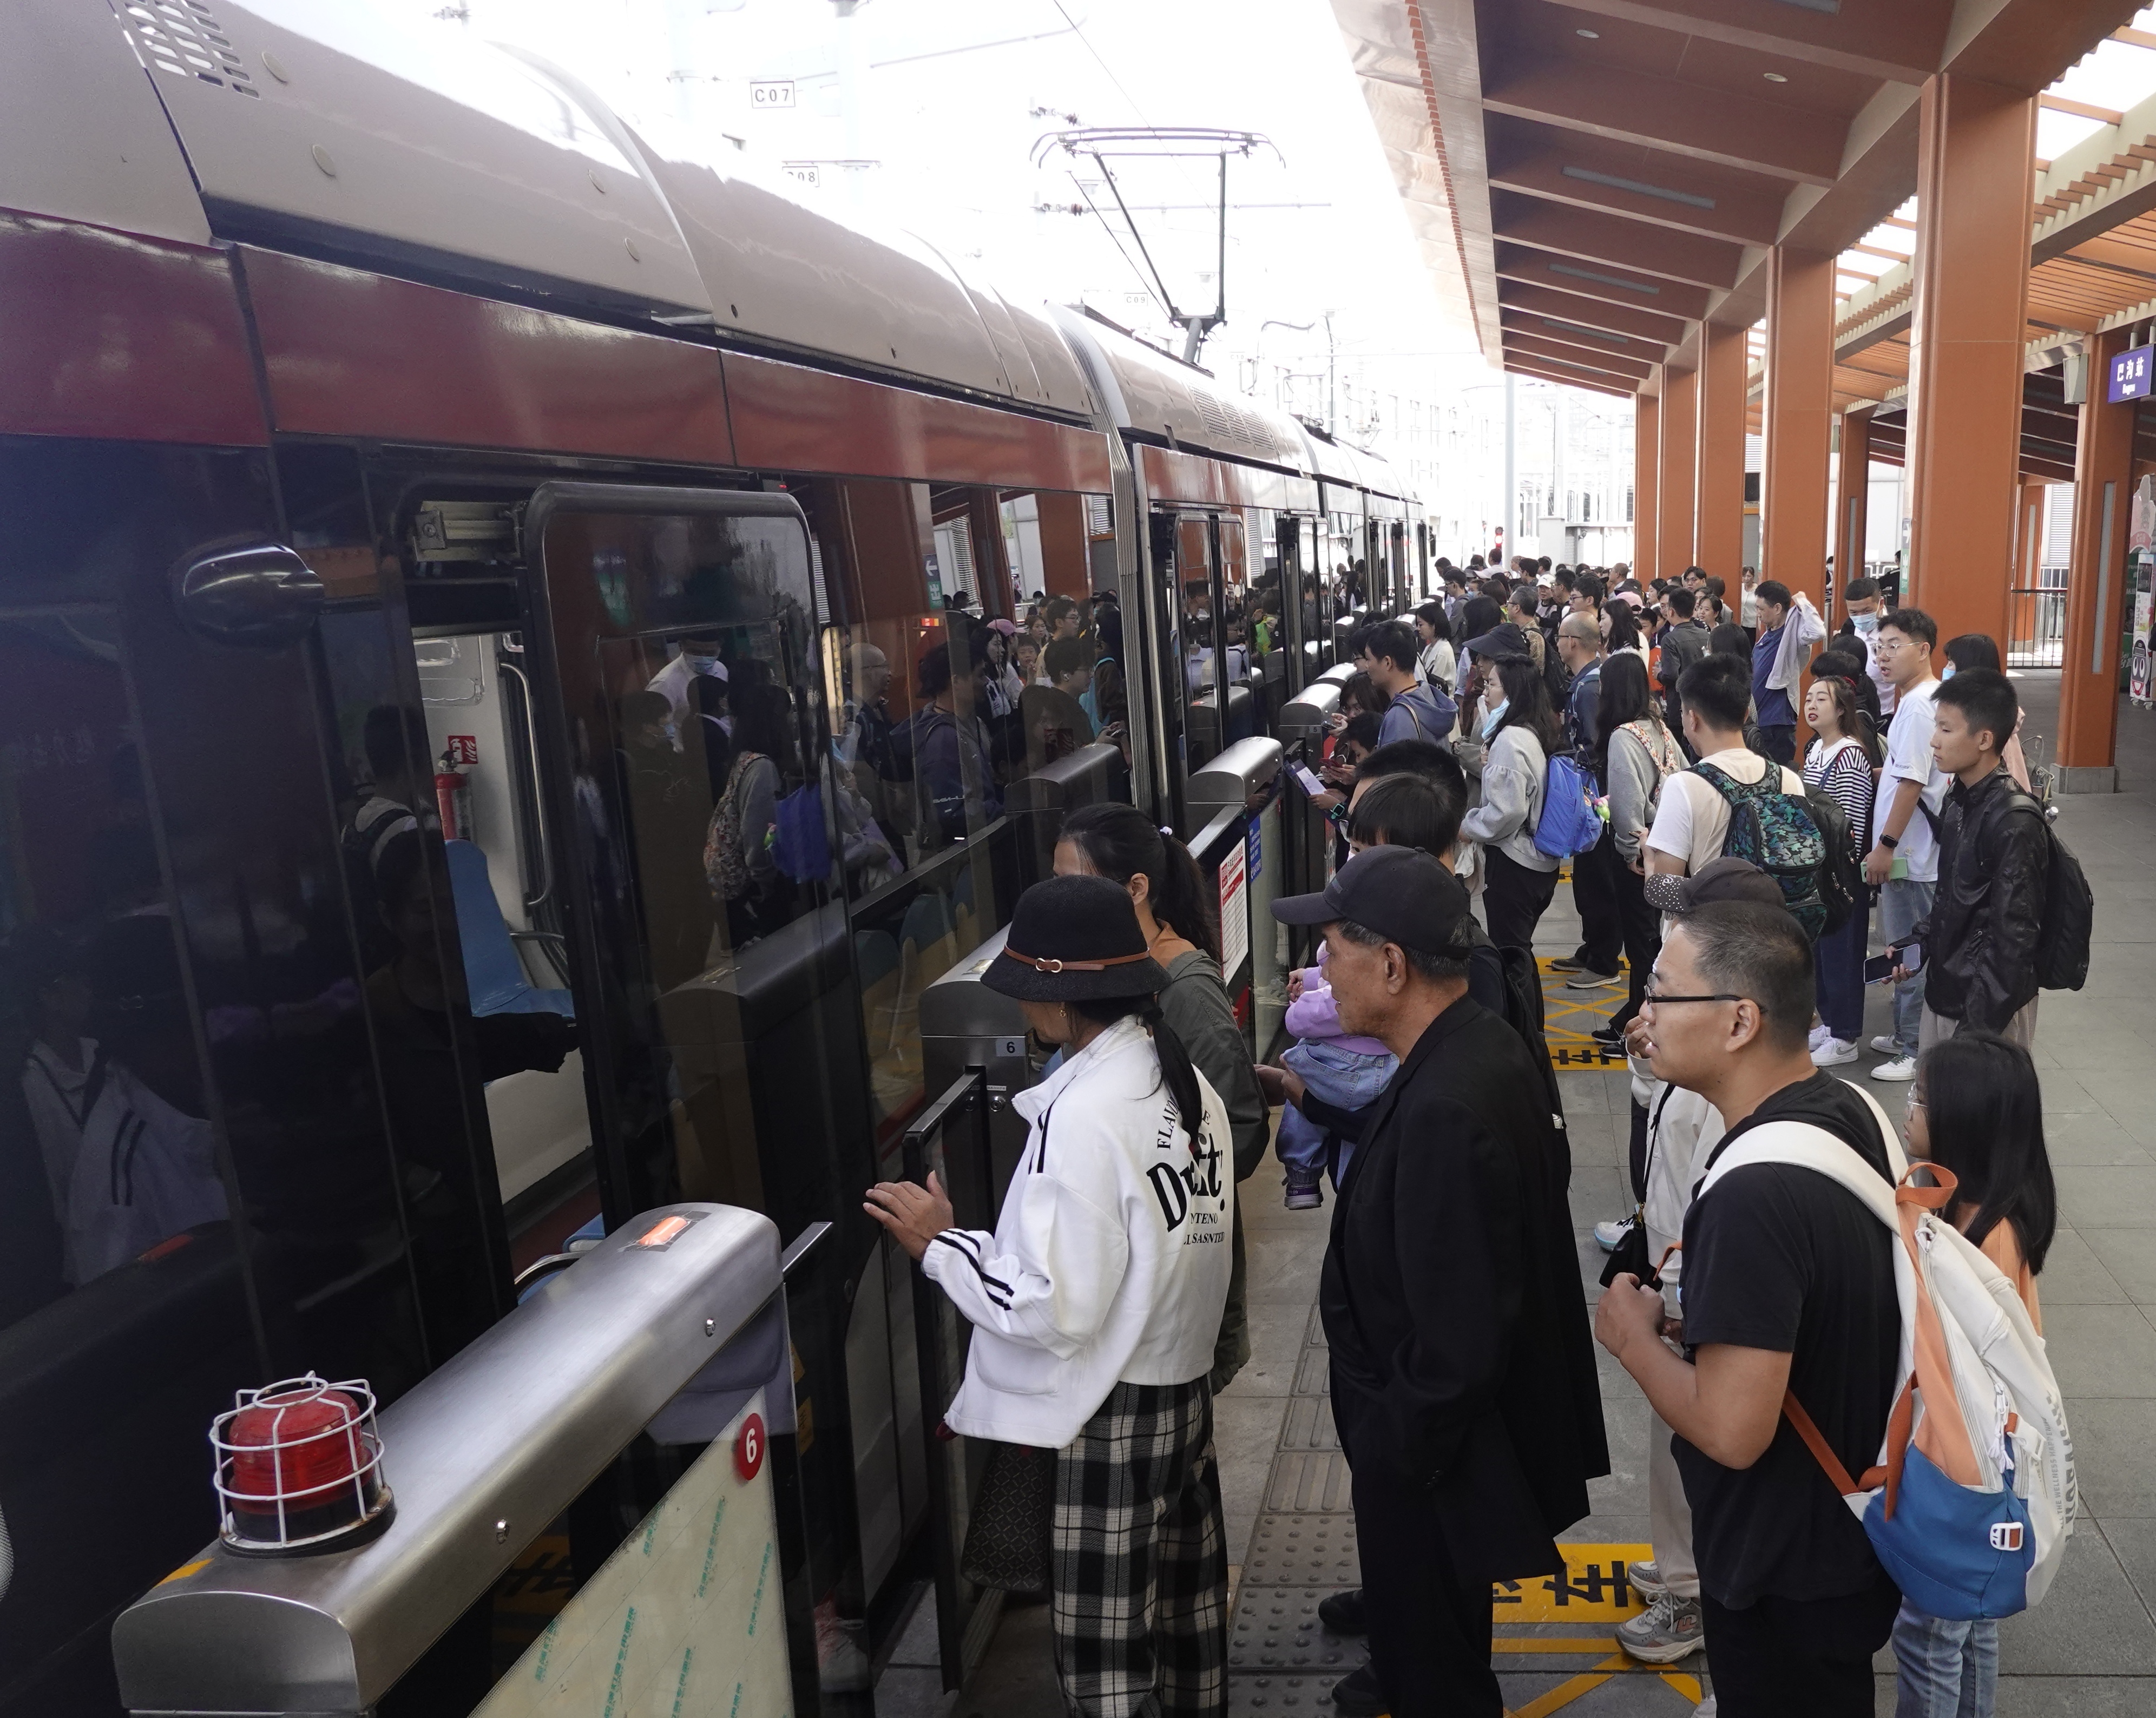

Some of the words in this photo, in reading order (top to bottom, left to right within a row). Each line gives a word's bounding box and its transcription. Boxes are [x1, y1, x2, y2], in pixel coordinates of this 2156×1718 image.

[754, 89, 789, 102] C07
[1006, 1041, 1015, 1054] 6
[745, 1427, 757, 1464] 6
[2050, 1458, 2061, 1499] WELLNESS
